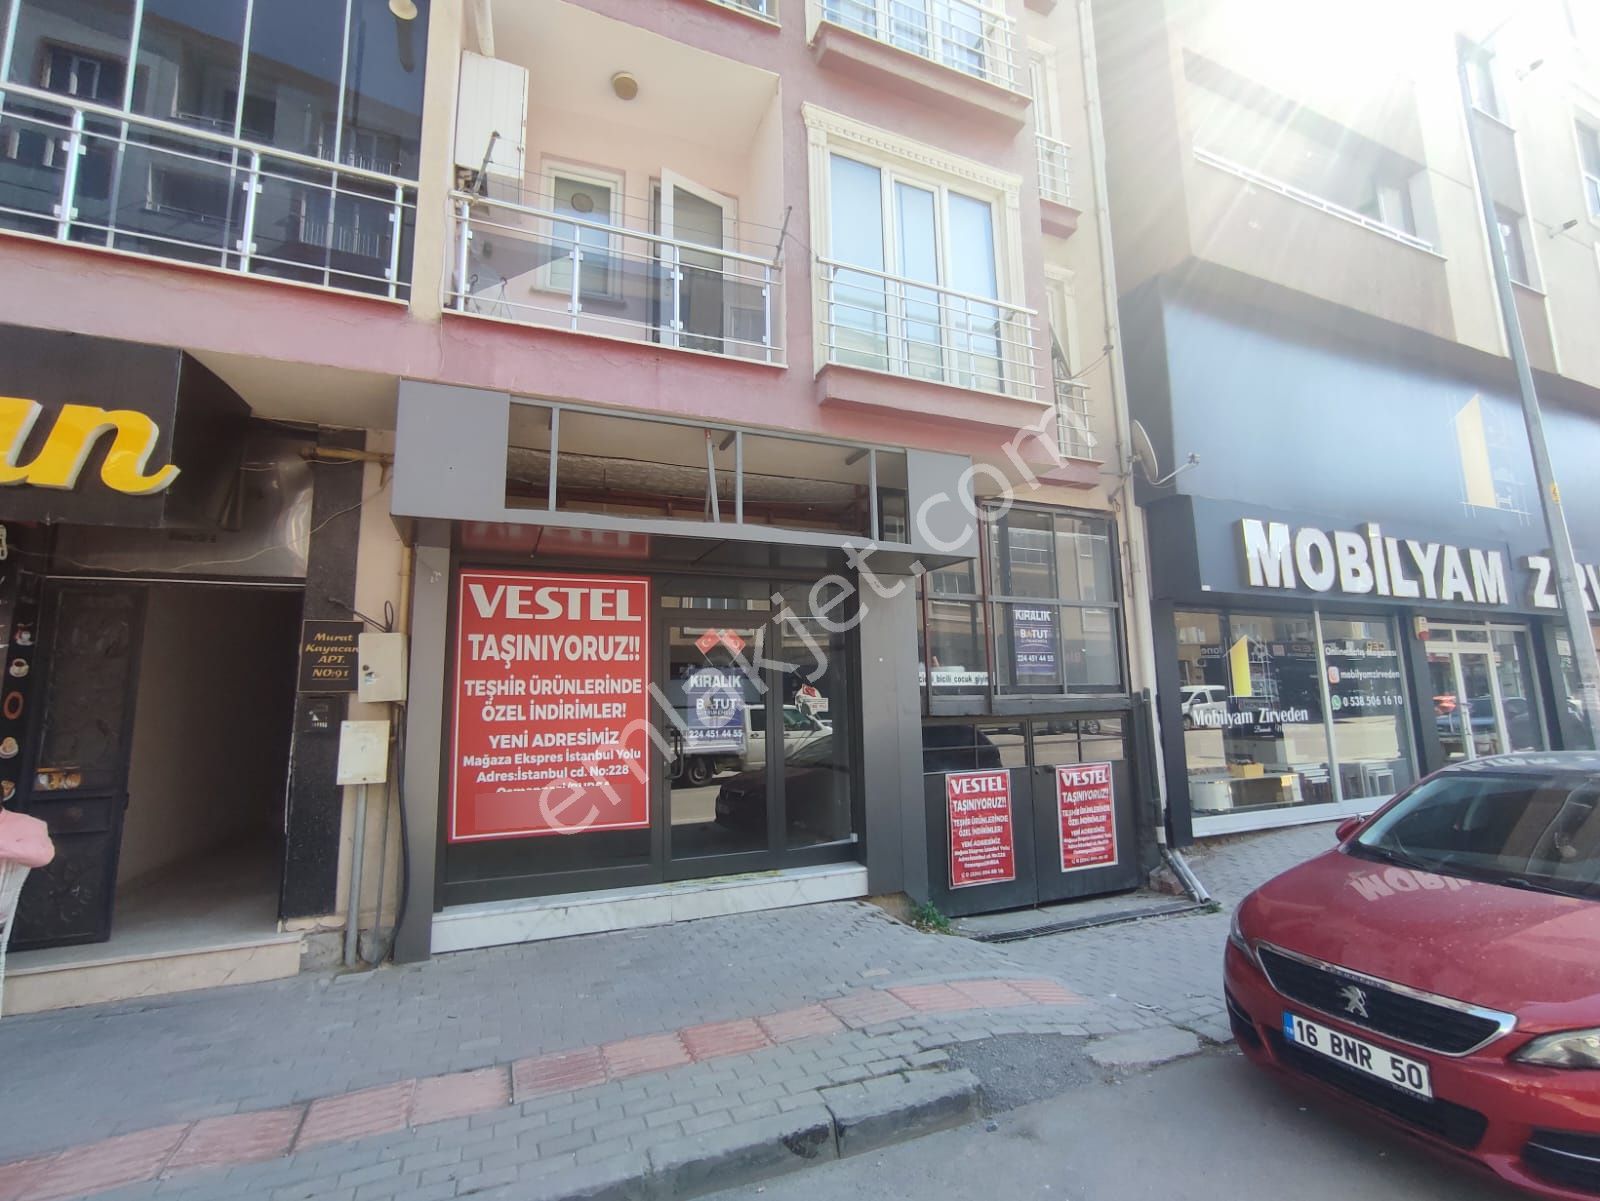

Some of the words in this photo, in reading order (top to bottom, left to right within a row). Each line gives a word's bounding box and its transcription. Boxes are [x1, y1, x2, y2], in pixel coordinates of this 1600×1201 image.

[1240, 517, 1509, 605] MOBİLYAM
[468, 583, 642, 622] VESTEL
[314, 632, 353, 642] Murat
[318, 655, 345, 664] APT.
[467, 634, 641, 669] TAŞINIYORUZ!!
[464, 675, 527, 700] TEŞHİR
[529, 674, 642, 696] ÜRÜNLERİNDE
[481, 700, 527, 722] ÖZEL
[529, 699, 627, 720] İNDİRİMLER!
[1382, 695, 1392, 705] 16
[1393, 695, 1403, 705] 10
[1192, 708, 1254, 729] Mobilyam
[1258, 706, 1309, 724] Zirveden
[488, 730, 529, 750] YENİ
[531, 727, 620, 748] ADRESİMİZ
[705, 729, 719, 738] 451
[721, 729, 732, 738] 44
[462, 755, 512, 769] Mağaza
[514, 753, 564, 766] Ekspres
[565, 748, 614, 763] İstanbul
[616, 748, 642, 760] Yolu
[569, 765, 587, 778] cd.
[589, 764, 630, 777] No:228
[1061, 770, 1108, 787] VESTEL
[950, 776, 1006, 794] VESTEL
[1296, 1020, 1319, 1047] 16
[1329, 1033, 1373, 1070] BNR
[1389, 1056, 1424, 1090] 50
